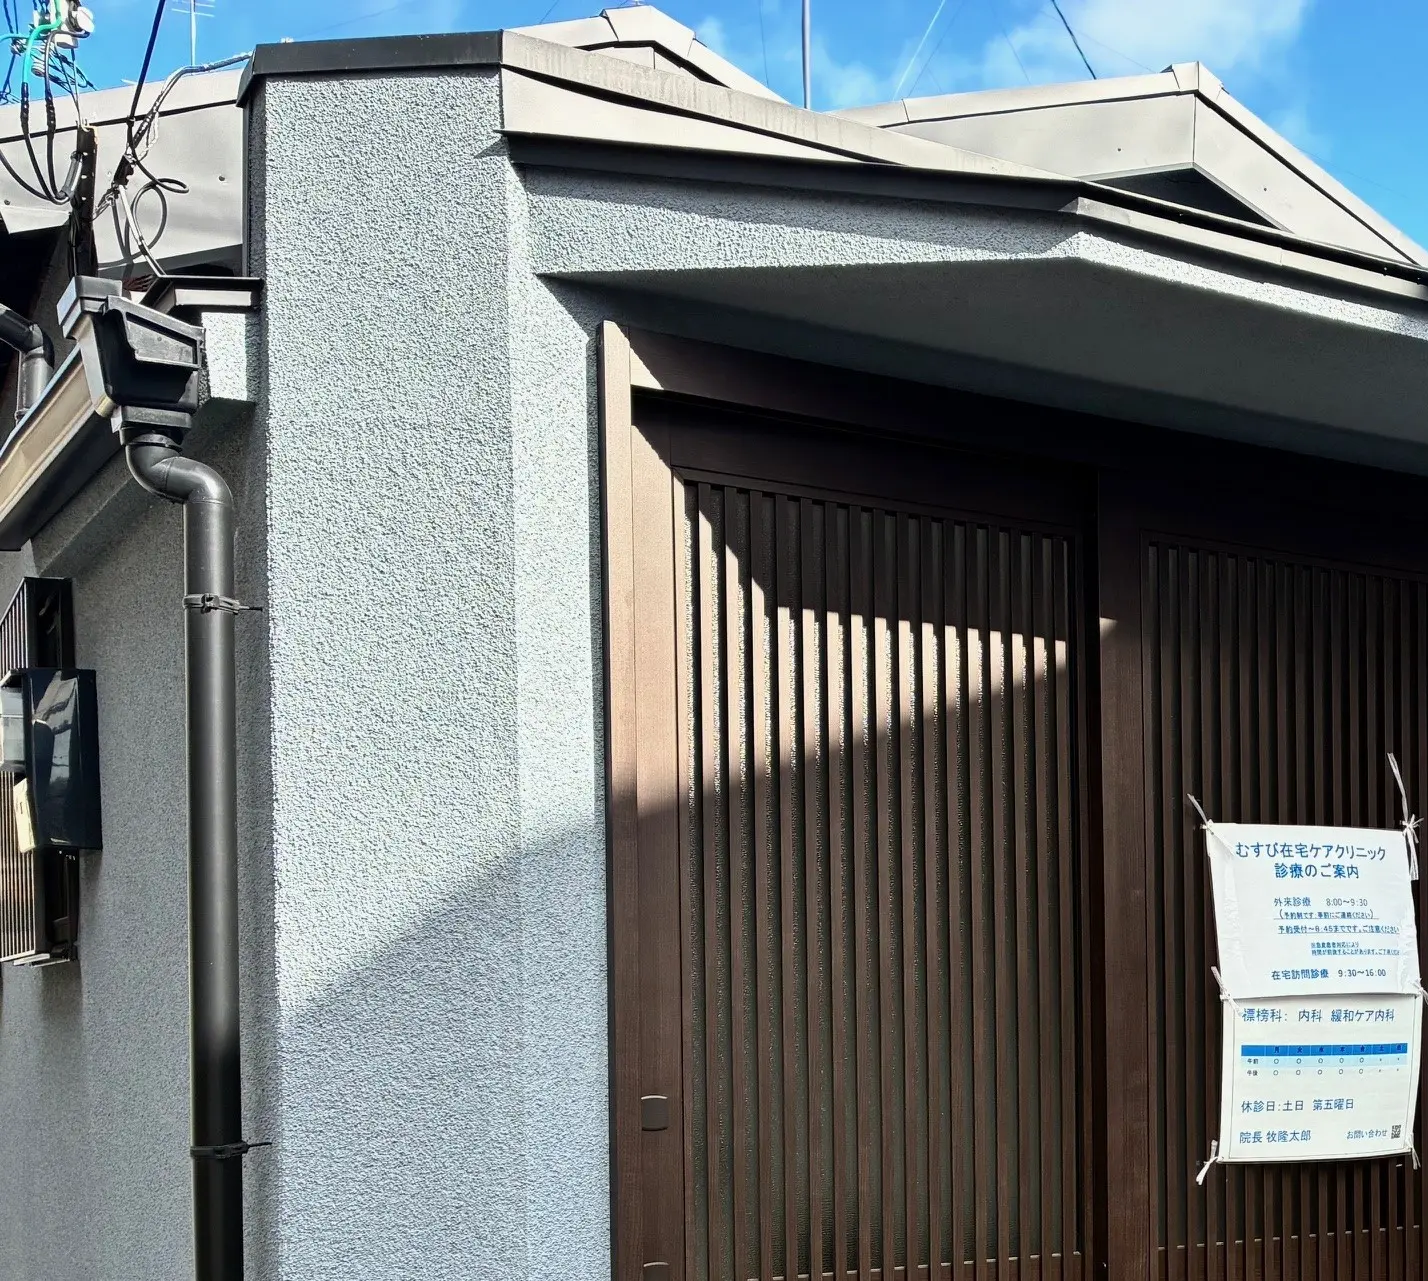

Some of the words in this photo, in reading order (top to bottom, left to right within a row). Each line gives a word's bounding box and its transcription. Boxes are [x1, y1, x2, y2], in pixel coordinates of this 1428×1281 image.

[1235, 842, 1386, 861] むすび在宅ケアクリニック
[1275, 863, 1360, 879] 診療のご案内
[1274, 897, 1311, 907] 外来診療
[1271, 969, 1329, 980] 在宅訪問診療
[1298, 1009, 1323, 1022] 内科
[1331, 1008, 1395, 1022] 緩和ケア内科
[1312, 1098, 1354, 1111] 第五曜日
[1239, 1132, 1263, 1144] 院長
[1267, 1130, 1311, 1143] 牧隆太郎
[1346, 1129, 1388, 1140] お問い合わせ
